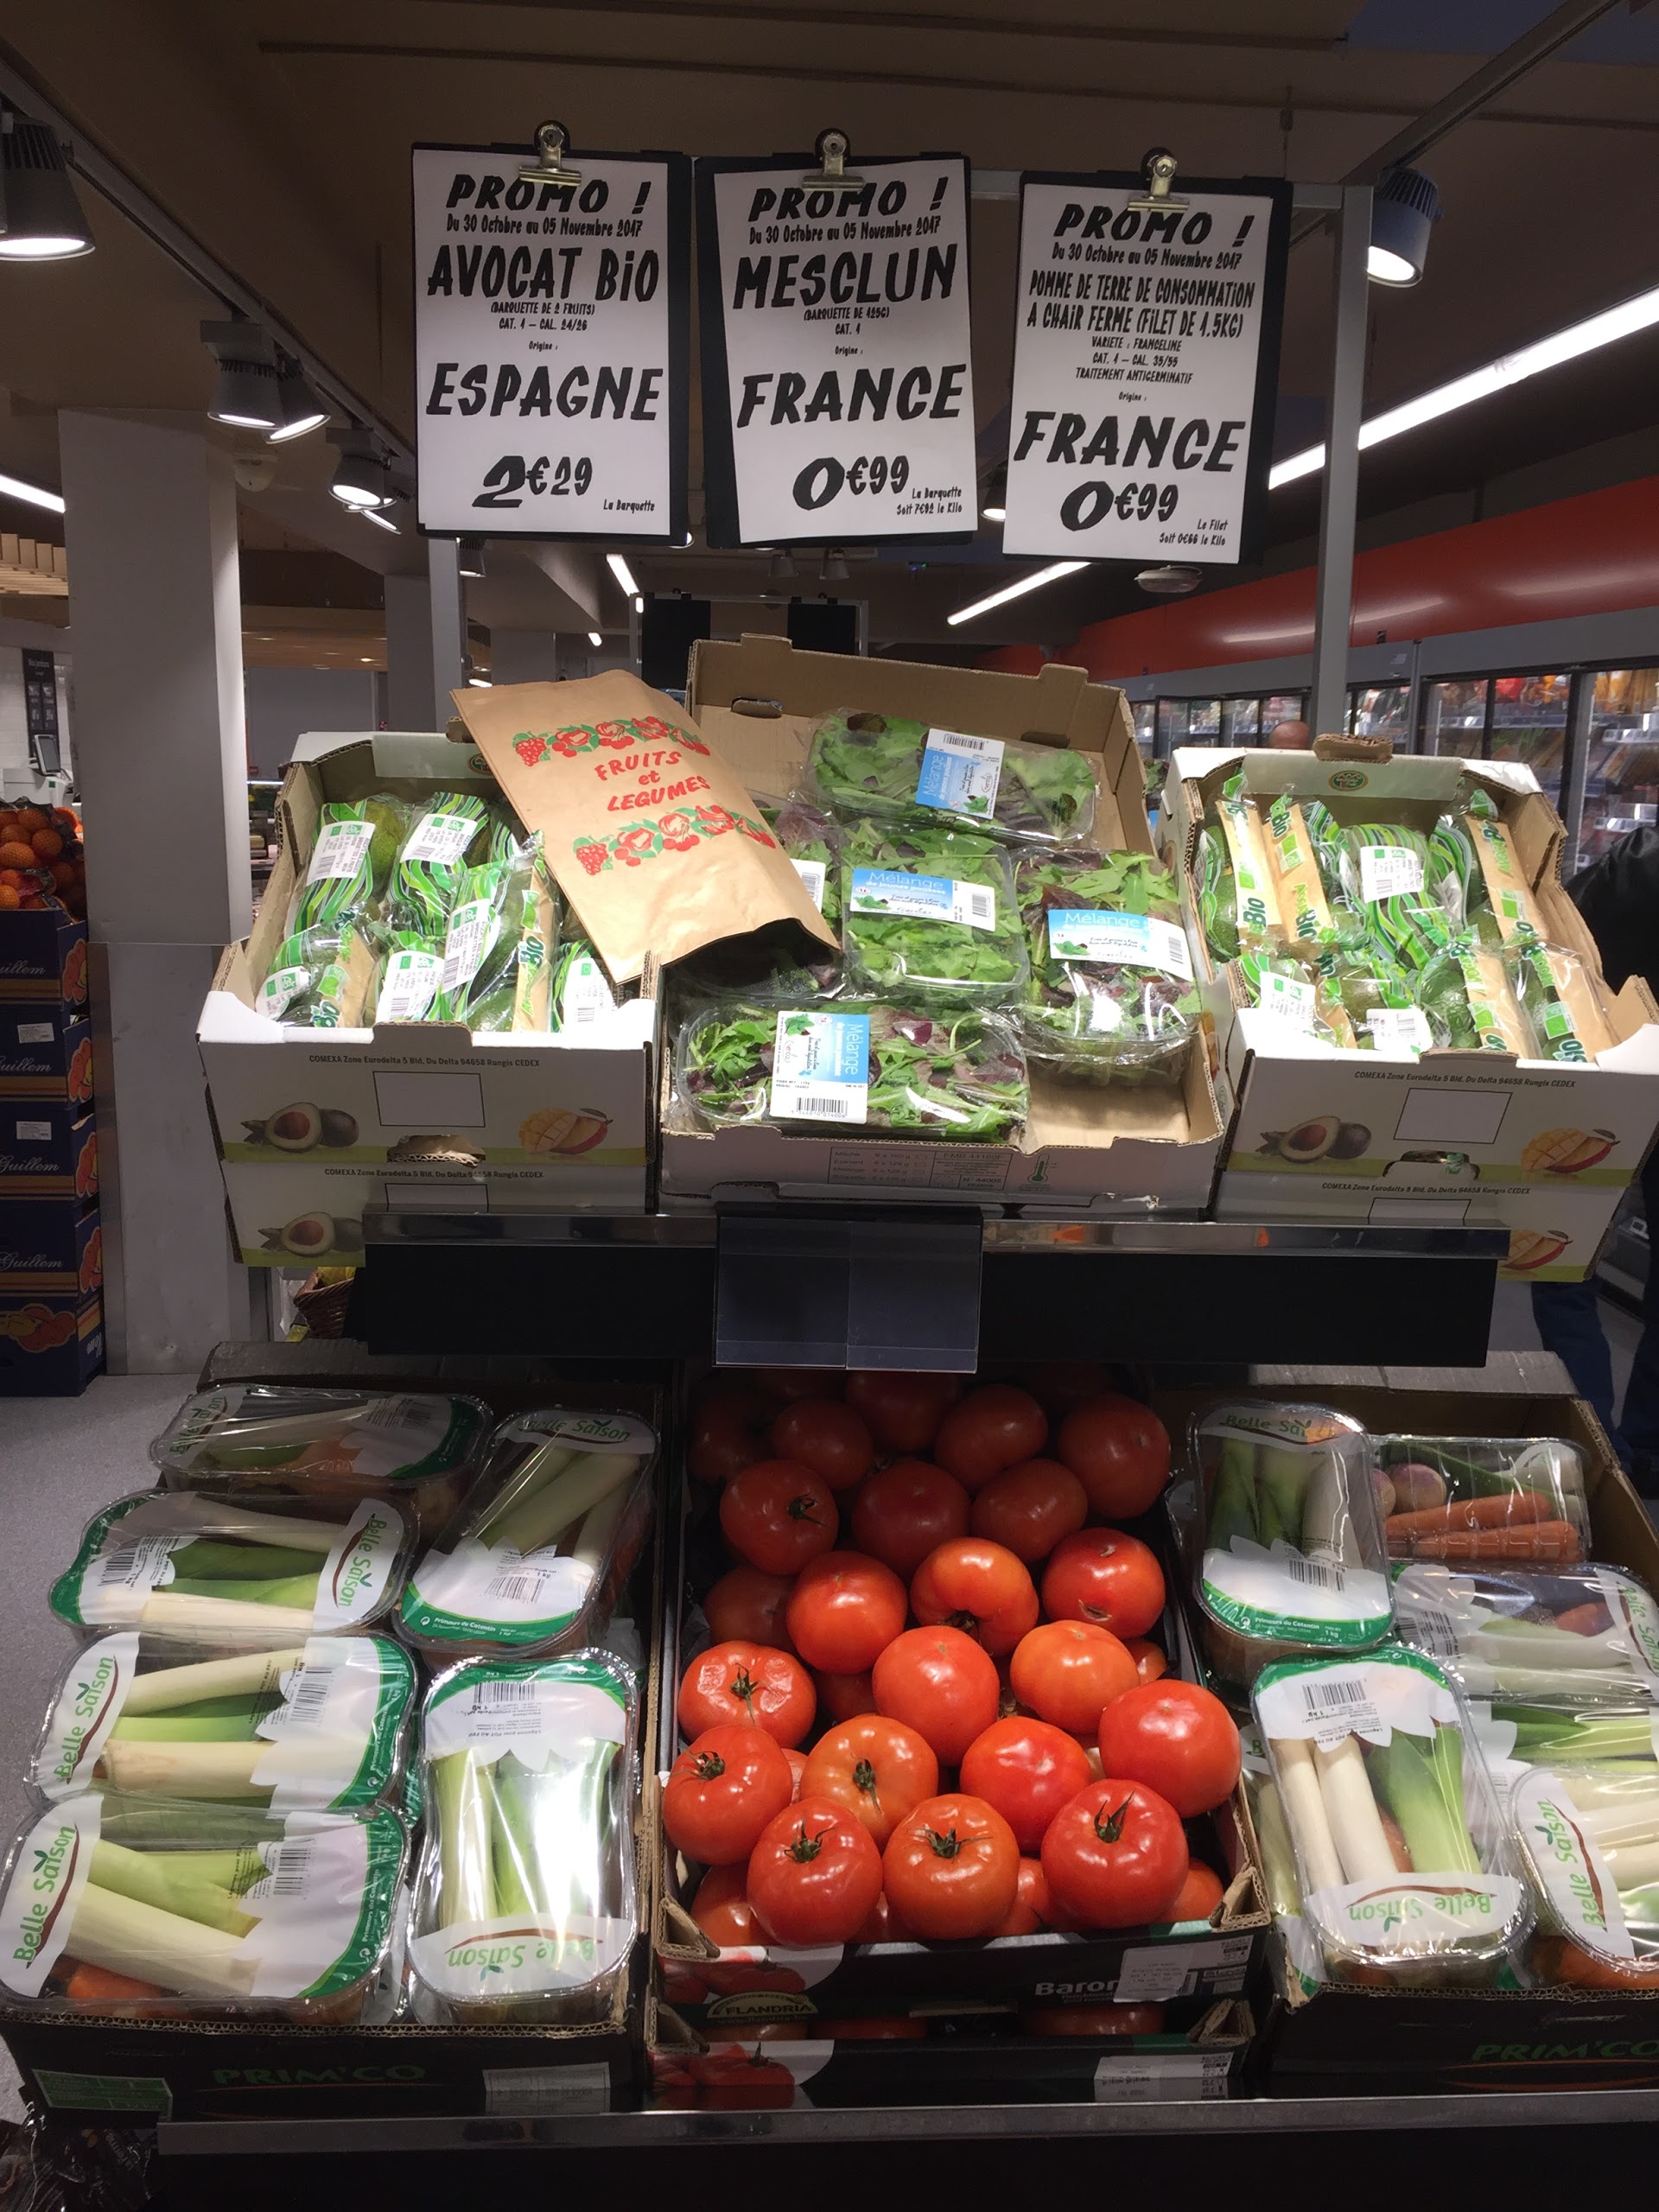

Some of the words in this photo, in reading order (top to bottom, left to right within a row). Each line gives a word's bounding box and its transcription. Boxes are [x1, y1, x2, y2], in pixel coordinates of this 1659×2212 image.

[446, 174, 609, 213] PROMO
[632, 181, 652, 214] !
[748, 181, 906, 222] PROMO
[929, 176, 949, 211] !
[447, 213, 459, 232] Du
[464, 214, 476, 232] 30
[481, 214, 521, 233] Octobre
[526, 220, 538, 234] au
[543, 218, 556, 234] 05
[562, 218, 613, 237] Novembre
[617, 219, 643, 238] 2017
[749, 227, 762, 244] Du
[766, 226, 779, 244] 30
[784, 224, 823, 243] Octobre
[828, 227, 839, 241] au
[844, 224, 856, 239] 05
[861, 220, 912, 240] Novembre
[915, 216, 941, 236] 2017
[1053, 204, 1212, 245] PROMO
[1232, 215, 1255, 247] !
[1052, 241, 1064, 259] Du
[1069, 243, 1082, 260] 30
[1085, 244, 1124, 264] Octobre
[1128, 251, 1140, 264] au
[1144, 248, 1158, 265] 05
[1161, 249, 1212, 269] Novembre
[1216, 252, 1242, 270] 2017
[428, 245, 582, 299] AVOCAT
[733, 244, 957, 309] MESCLUN
[1029, 270, 1073, 299] POMME
[1077, 273, 1092, 299] DE
[1097, 274, 1132, 302] TERRE
[1135, 276, 1152, 302] DE
[491, 302, 538, 315] (BARQUETTE
[542, 302, 552, 315] DE
[555, 304, 560, 315] 2
[563, 303, 594, 315] FRUITS)
[804, 307, 850, 321] (BARQUETTE
[854, 307, 863, 319] DE
[499, 318, 516, 330] CAT.
[540, 318, 556, 331] CAL.
[561, 318, 587, 331] 24/26
[836, 323, 851, 335] CAT.
[1027, 302, 1037, 327] A
[1088, 305, 1134, 334] FERME
[1179, 309, 1195, 337] DE
[1199, 311, 1243, 339] 1.5KG)
[529, 340, 552, 352] Origine
[836, 346, 858, 356] Origine
[1092, 336, 1123, 349] VARIETE
[1134, 338, 1182, 353] FRANCELINE
[1093, 353, 1109, 364] CAT.
[1132, 353, 1148, 366] CAL.
[1154, 355, 1179, 367] 35/55
[1076, 367, 1124, 381] TRAITEMENT
[1126, 368, 1193, 385] ANTIGERMINATIF
[426, 363, 664, 420] ESPAGNE
[737, 364, 966, 428] FRANCE
[1119, 391, 1141, 402] Origine
[1014, 410, 1246, 472] FRANCE
[912, 488, 921, 499] La
[925, 486, 962, 501] Barquette
[603, 499, 613, 511] La
[616, 500, 655, 514] Barquette
[896, 504, 913, 516] Soit
[915, 504, 934, 515] 7€92
[938, 503, 944, 513] le
[948, 503, 963, 513] Kilo
[1197, 518, 1207, 530] Le
[1210, 519, 1228, 531] Filet
[1160, 532, 1176, 544] Soit
[1201, 533, 1208, 545] le
[1211, 534, 1226, 546] Kilo
[594, 750, 682, 781] FRUITS
[923, 754, 944, 798] Mélange
[639, 770, 660, 785] et
[607, 775, 711, 812] LEGUMES
[869, 872, 944, 888] Mélange
[1065, 912, 1140, 930] Mélange
[844, 1023, 863, 1075] Mélange
[486, 1059, 513, 1068] Rungis
[1355, 1071, 1385, 1080] COMEXA
[1406, 1073, 1442, 1082] Eurodelta
[1478, 1076, 1497, 1084] Delta
[1498, 1077, 1522, 1085] 94658
[1523, 1078, 1550, 1088] Rungis
[493, 1171, 518, 1179] Rungis
[1481, 1186, 1506, 1195] Rungis
[572, 1419, 631, 1441] Saison
[1225, 1414, 1270, 1429] Belle
[358, 1516, 388, 1555] Belle
[337, 1556, 372, 1608] Saison
[54, 1725, 85, 1779] Belle
[75, 1656, 114, 1718] Saison
[1537, 1799, 1579, 1865] Saison
[14, 1903, 48, 1962] Belle
[33, 1825, 76, 1893] Saison
[1435, 1894, 1492, 1914] Belle
[1568, 1872, 1605, 1929] Belle
[448, 1944, 524, 1968] Saison
[725, 2005, 811, 2015] FLANDRIA
